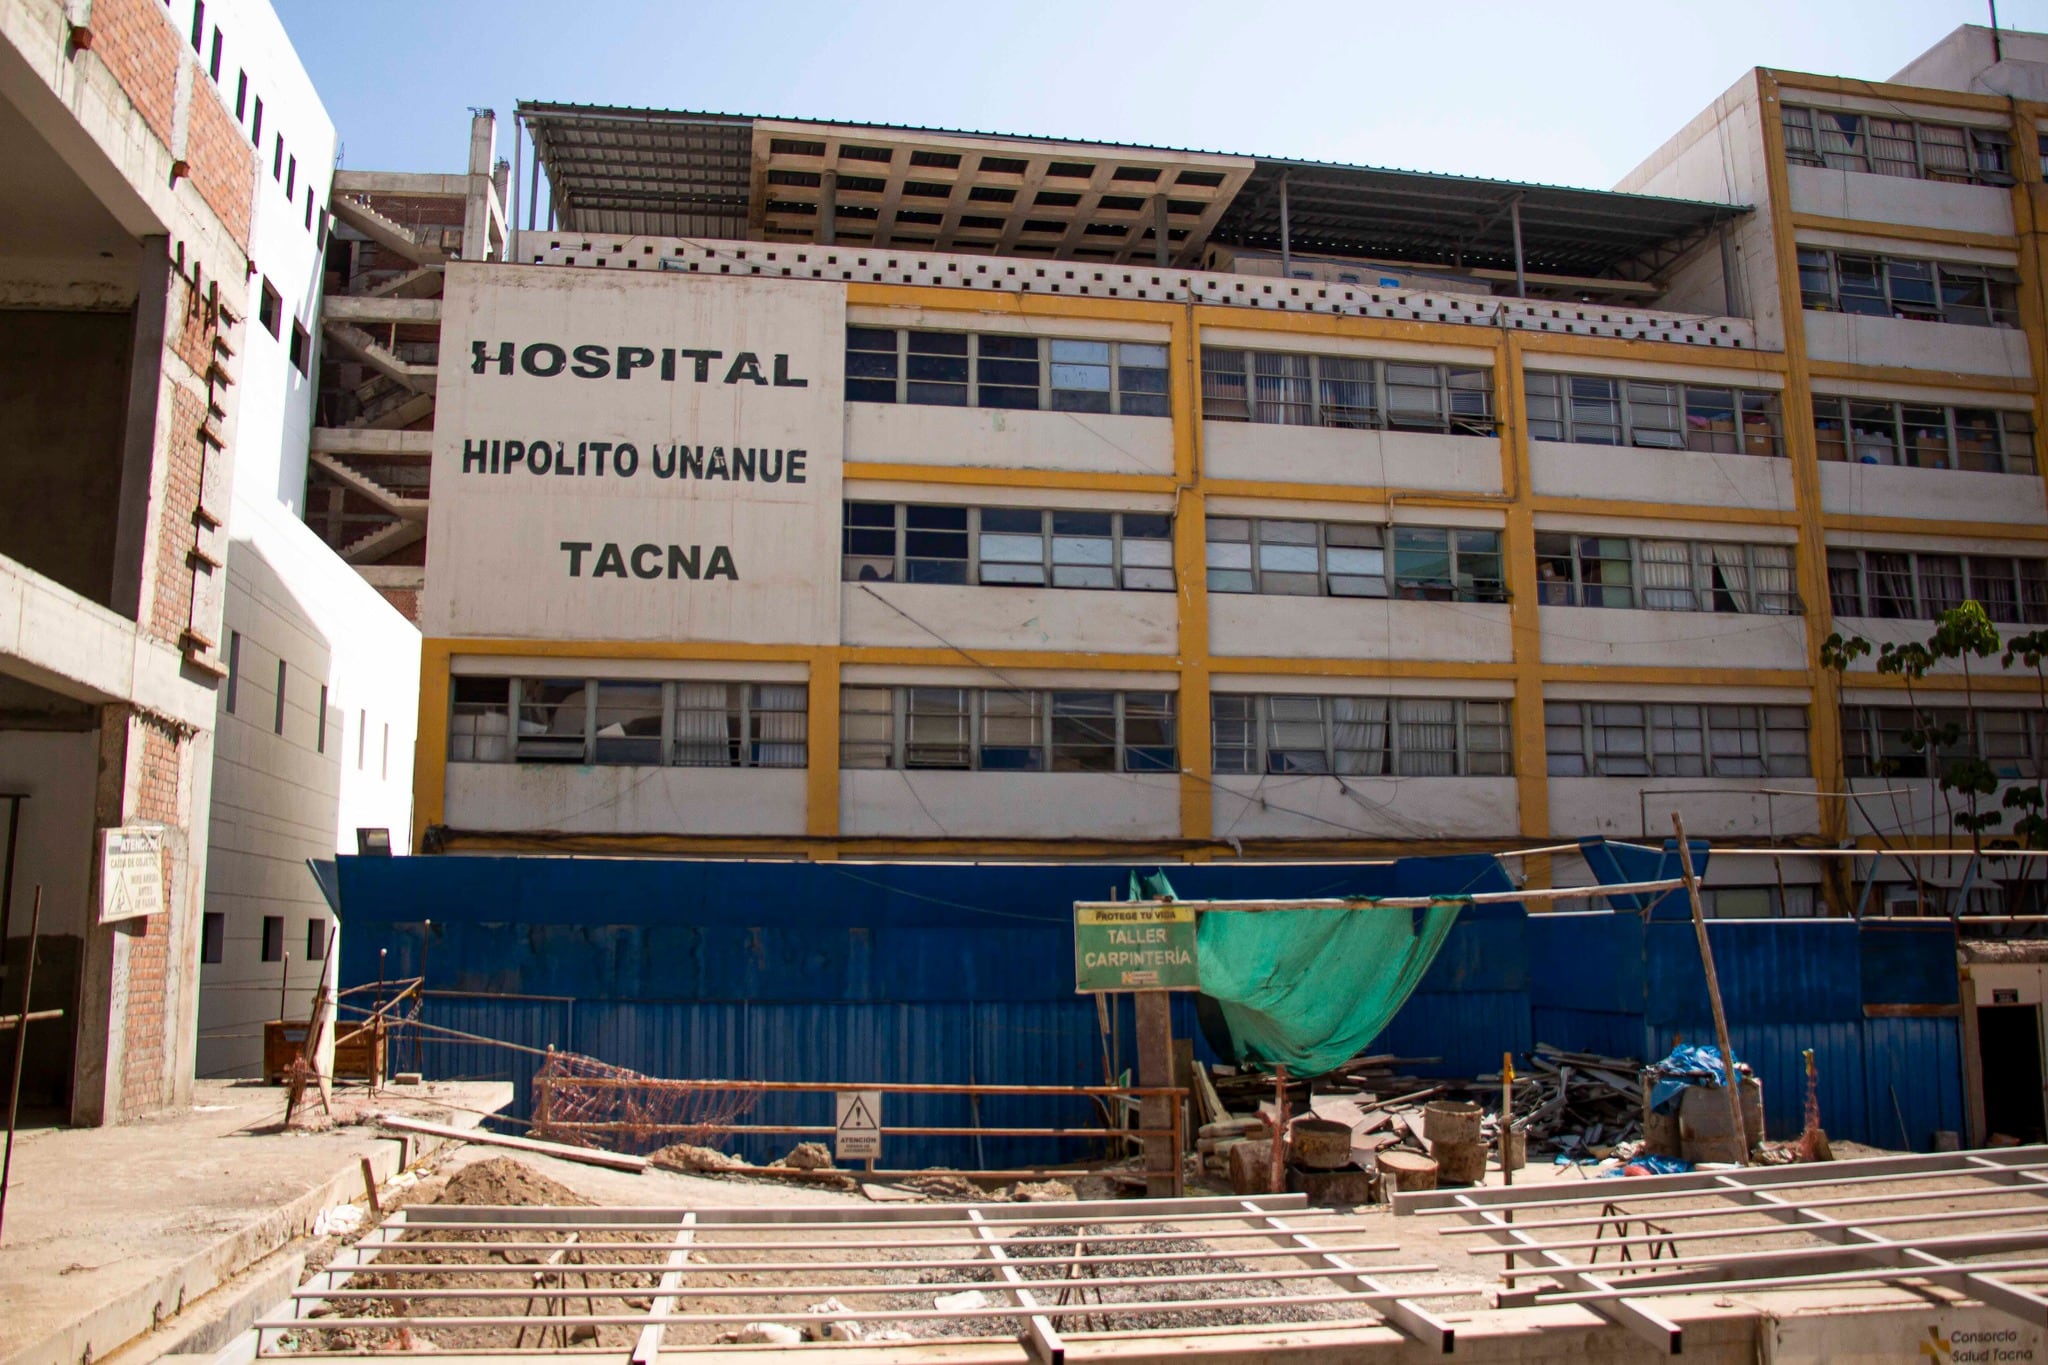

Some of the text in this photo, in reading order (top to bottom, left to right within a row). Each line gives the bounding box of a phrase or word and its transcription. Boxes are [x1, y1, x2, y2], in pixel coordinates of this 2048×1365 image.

[471, 340, 808, 388] HOSPITAL
[462, 438, 807, 484] HIPOLITO UNANUE
[560, 541, 740, 581] TACNA
[1096, 911, 1138, 921] PROTEGE
[1140, 911, 1153, 920] TU
[1108, 928, 1167, 944] TALLER
[1085, 946, 1192, 968] CARPINTERÍA
[840, 1135, 877, 1144] ATENCIÓN
[1951, 1330, 2017, 1343] Consorcio
[1952, 1348, 2033, 1363] Salud Tacna
